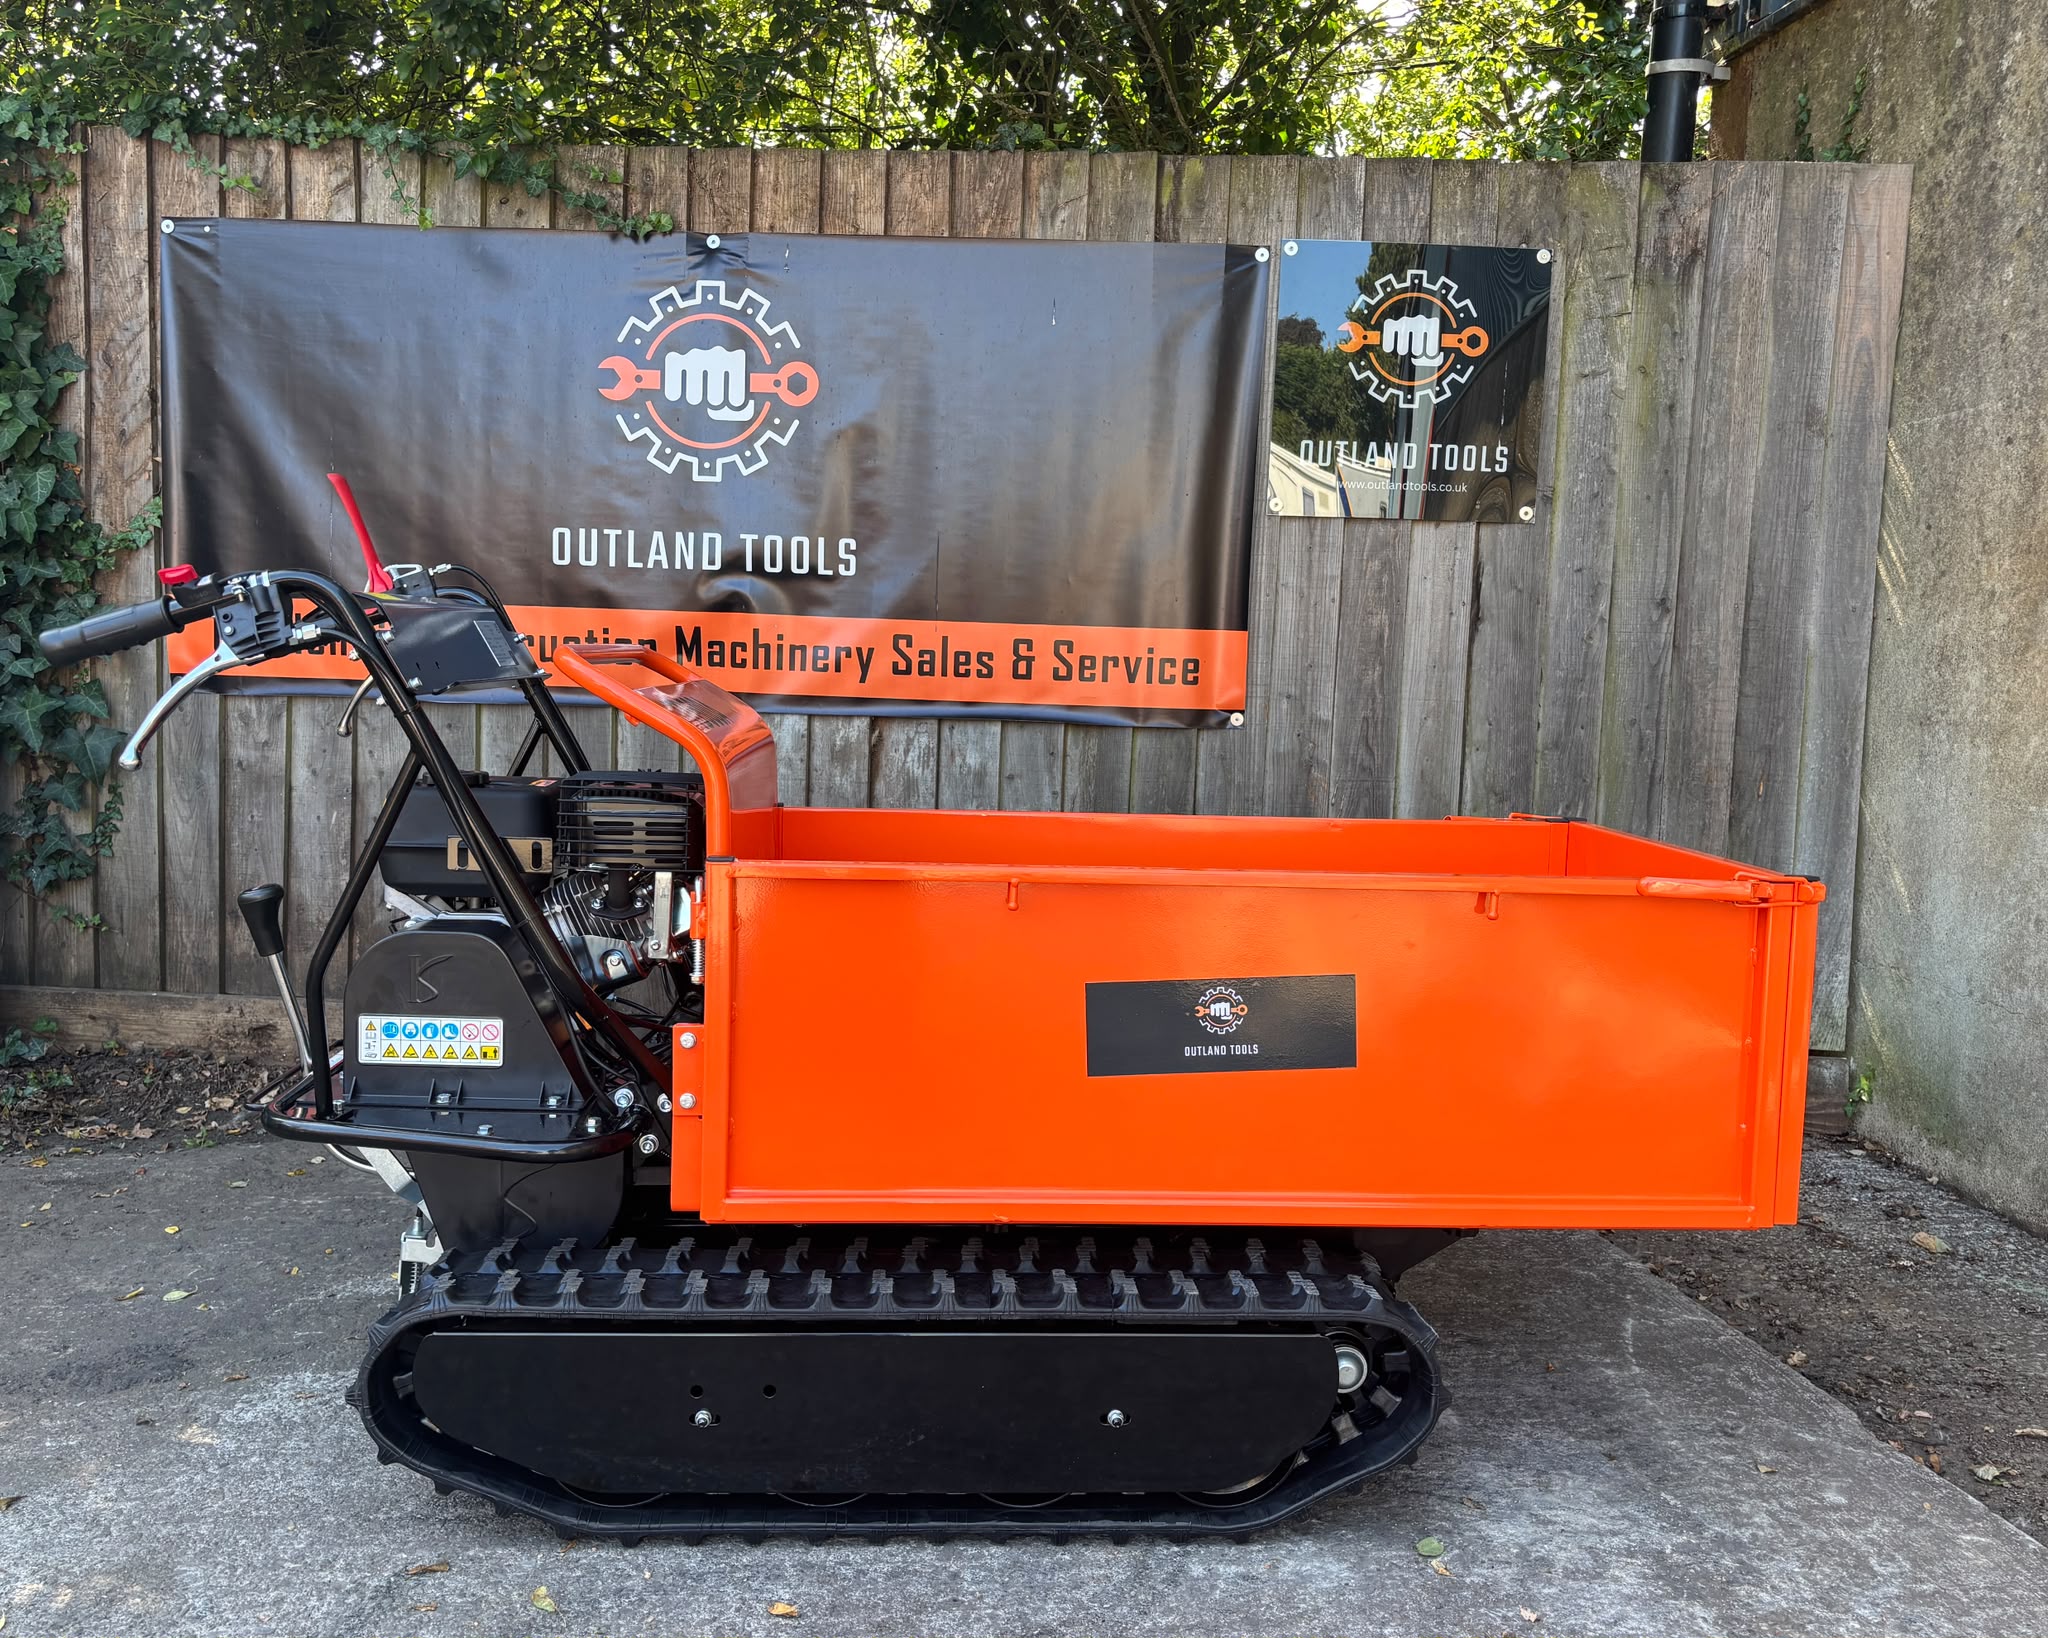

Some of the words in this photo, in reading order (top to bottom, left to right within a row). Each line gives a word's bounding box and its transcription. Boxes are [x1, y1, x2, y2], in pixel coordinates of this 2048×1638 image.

[1300, 439, 1417, 470] OUTLAND
[1430, 443, 1509, 473] TOOLS
[1338, 479, 1468, 493] www.outlandtools.co.uk
[552, 527, 722, 571] OUTLAND
[740, 533, 857, 576] TOOLS
[675, 625, 875, 683] Machinery
[892, 634, 994, 678] Sales
[1012, 638, 1036, 680] &
[1052, 639, 1200, 685] Service
[1184, 1045, 1227, 1056] OUTLAND
[1230, 1044, 1259, 1055] TOOLS
